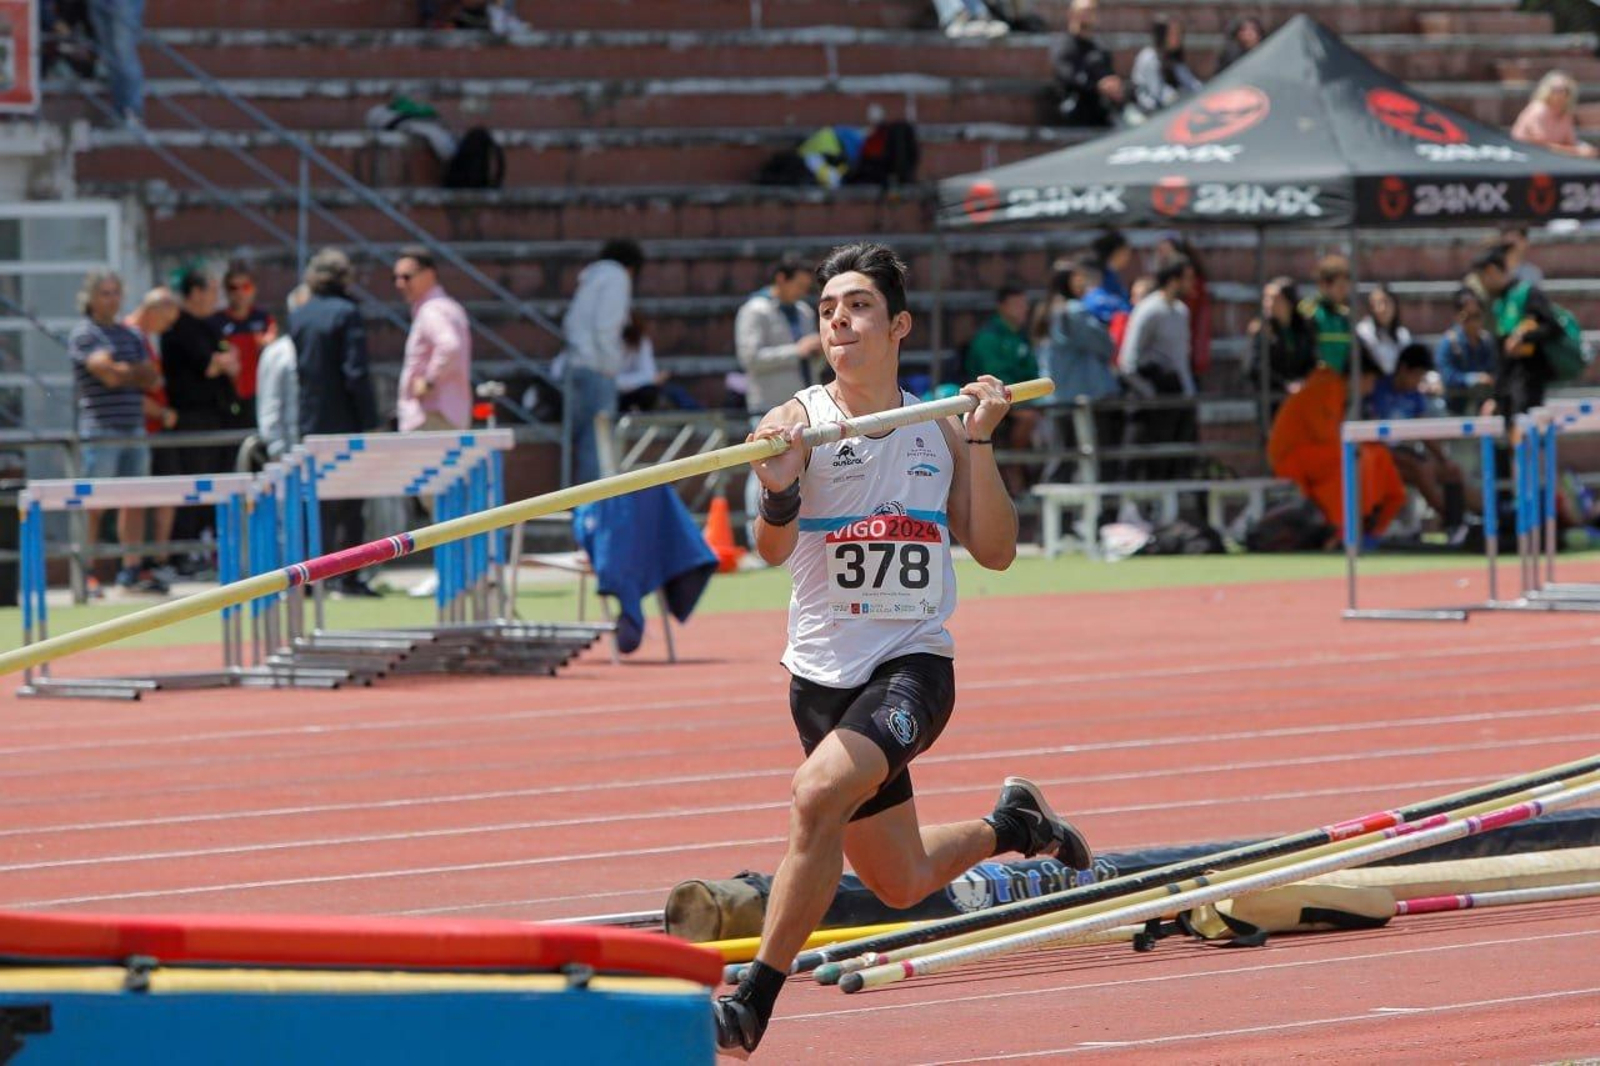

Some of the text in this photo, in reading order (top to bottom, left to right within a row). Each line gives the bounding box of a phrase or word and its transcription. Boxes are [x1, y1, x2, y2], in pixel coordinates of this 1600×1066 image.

[1193, 182, 1325, 218] 24MX
[1413, 182, 1511, 215] 24MX
[835, 543, 930, 589] 378
